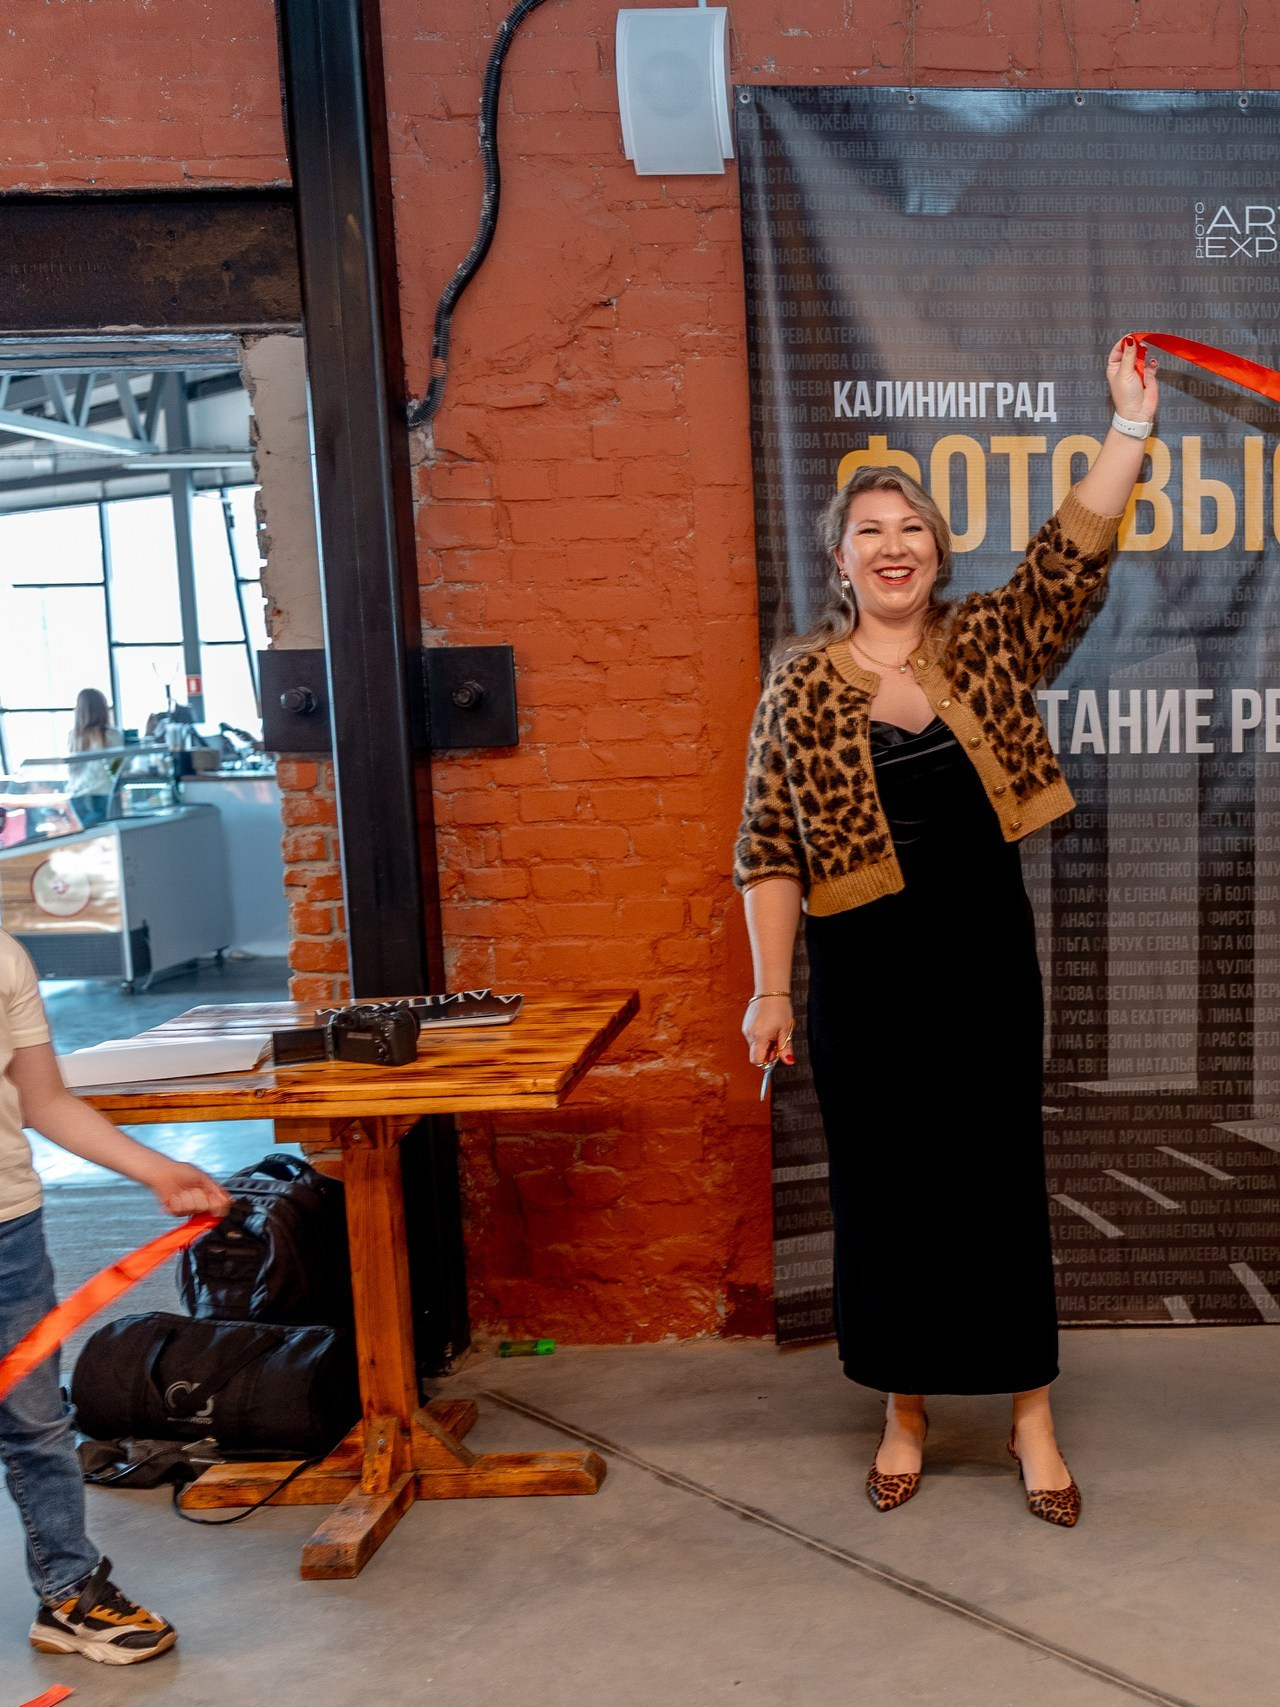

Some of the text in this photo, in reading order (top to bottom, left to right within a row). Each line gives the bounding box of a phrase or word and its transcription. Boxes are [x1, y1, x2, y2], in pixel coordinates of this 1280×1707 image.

[1087, 143, 1156, 159] СВЕТЛАНА
[1160, 144, 1222, 160] МИХЕЕВА
[1123, 170, 1198, 186] ЕКАТЕРИНА
[1195, 202, 1205, 259] PHOTO
[1222, 276, 1280, 292] ПЕТРОВА
[834, 381, 1057, 421] КАЛИНИНГРАД
[1037, 688, 1214, 754] ТАНИЕ
